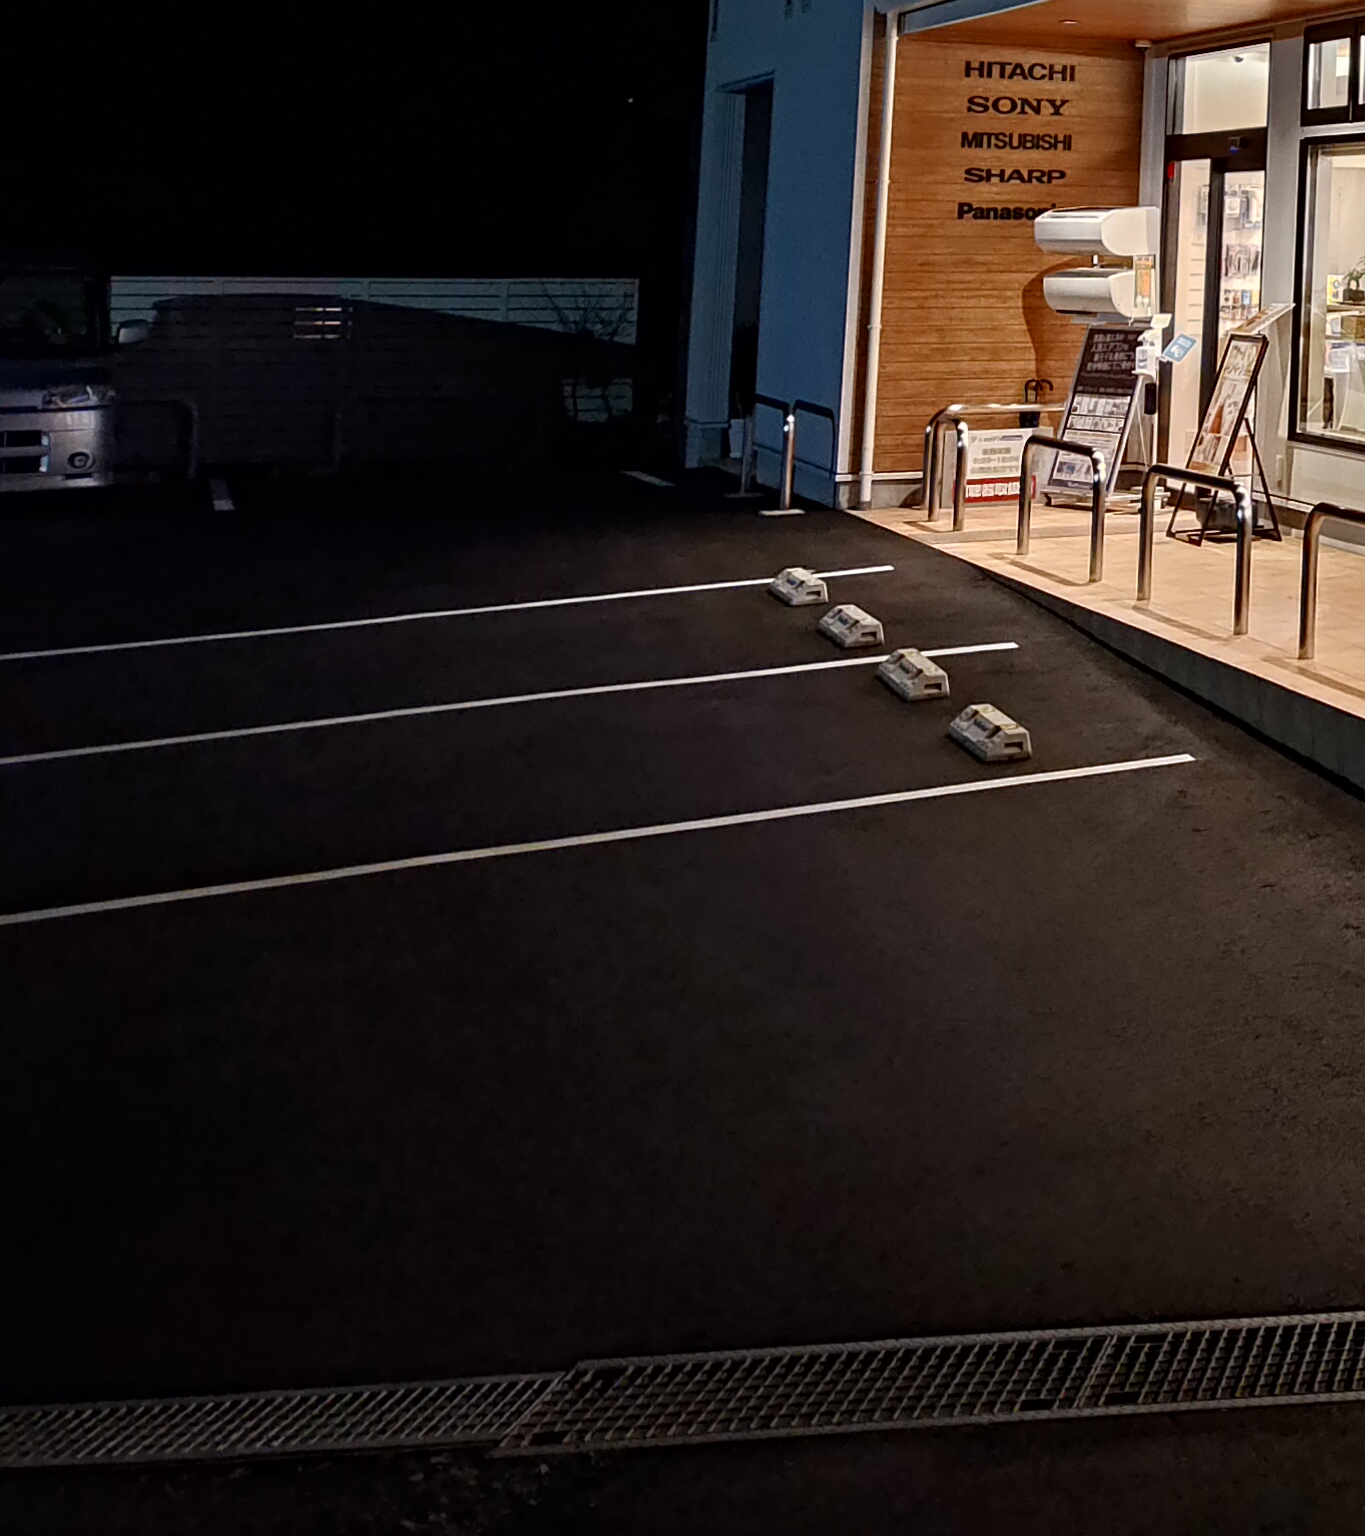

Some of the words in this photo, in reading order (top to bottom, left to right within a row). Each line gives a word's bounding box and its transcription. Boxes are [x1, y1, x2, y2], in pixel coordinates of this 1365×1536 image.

[964, 61, 1076, 81] HITACHI
[966, 95, 1070, 116] SONY
[960, 131, 1073, 152] MITSUBISHI
[963, 167, 1067, 184] SHARP
[957, 201, 1057, 221] Panaso
